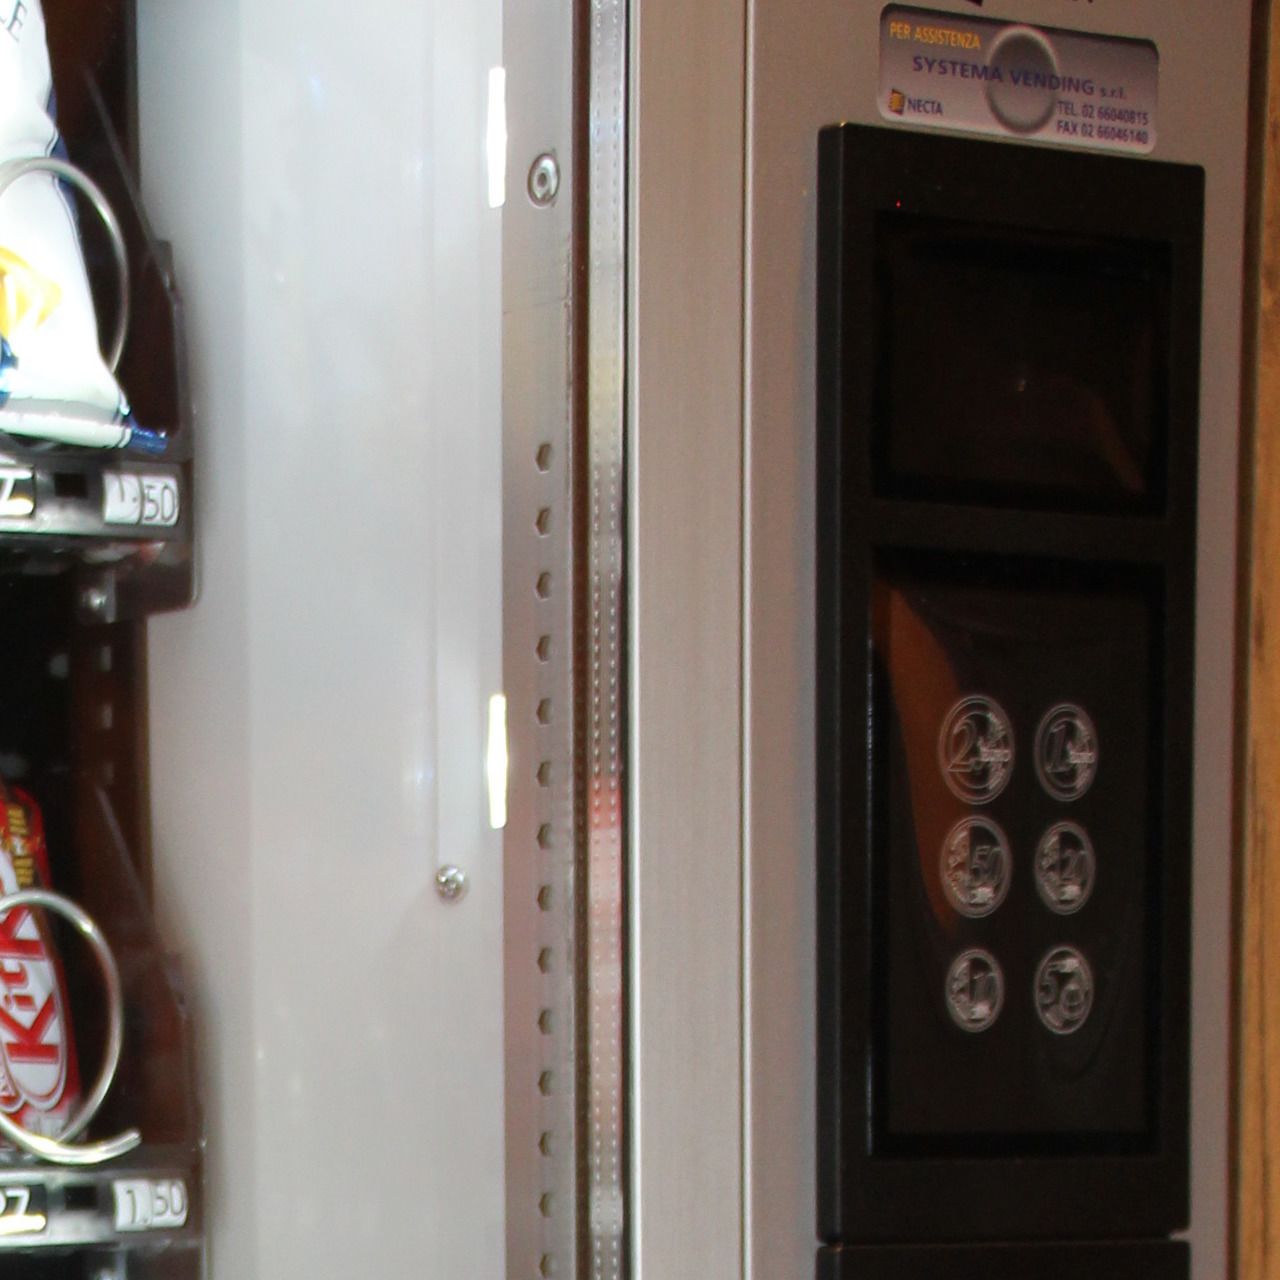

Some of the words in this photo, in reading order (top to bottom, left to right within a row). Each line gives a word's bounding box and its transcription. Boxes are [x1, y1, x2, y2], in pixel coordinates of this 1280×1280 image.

[888, 21, 911, 40] PER
[913, 25, 982, 50] ASSISTENZA
[912, 55, 1004, 83] SYSTEMA
[1009, 69, 1096, 97] VENDING
[906, 97, 944, 117] NECTA
[1081, 102, 1095, 120] 02
[1056, 119, 1079, 136] FAX
[1081, 122, 1095, 138] 02
